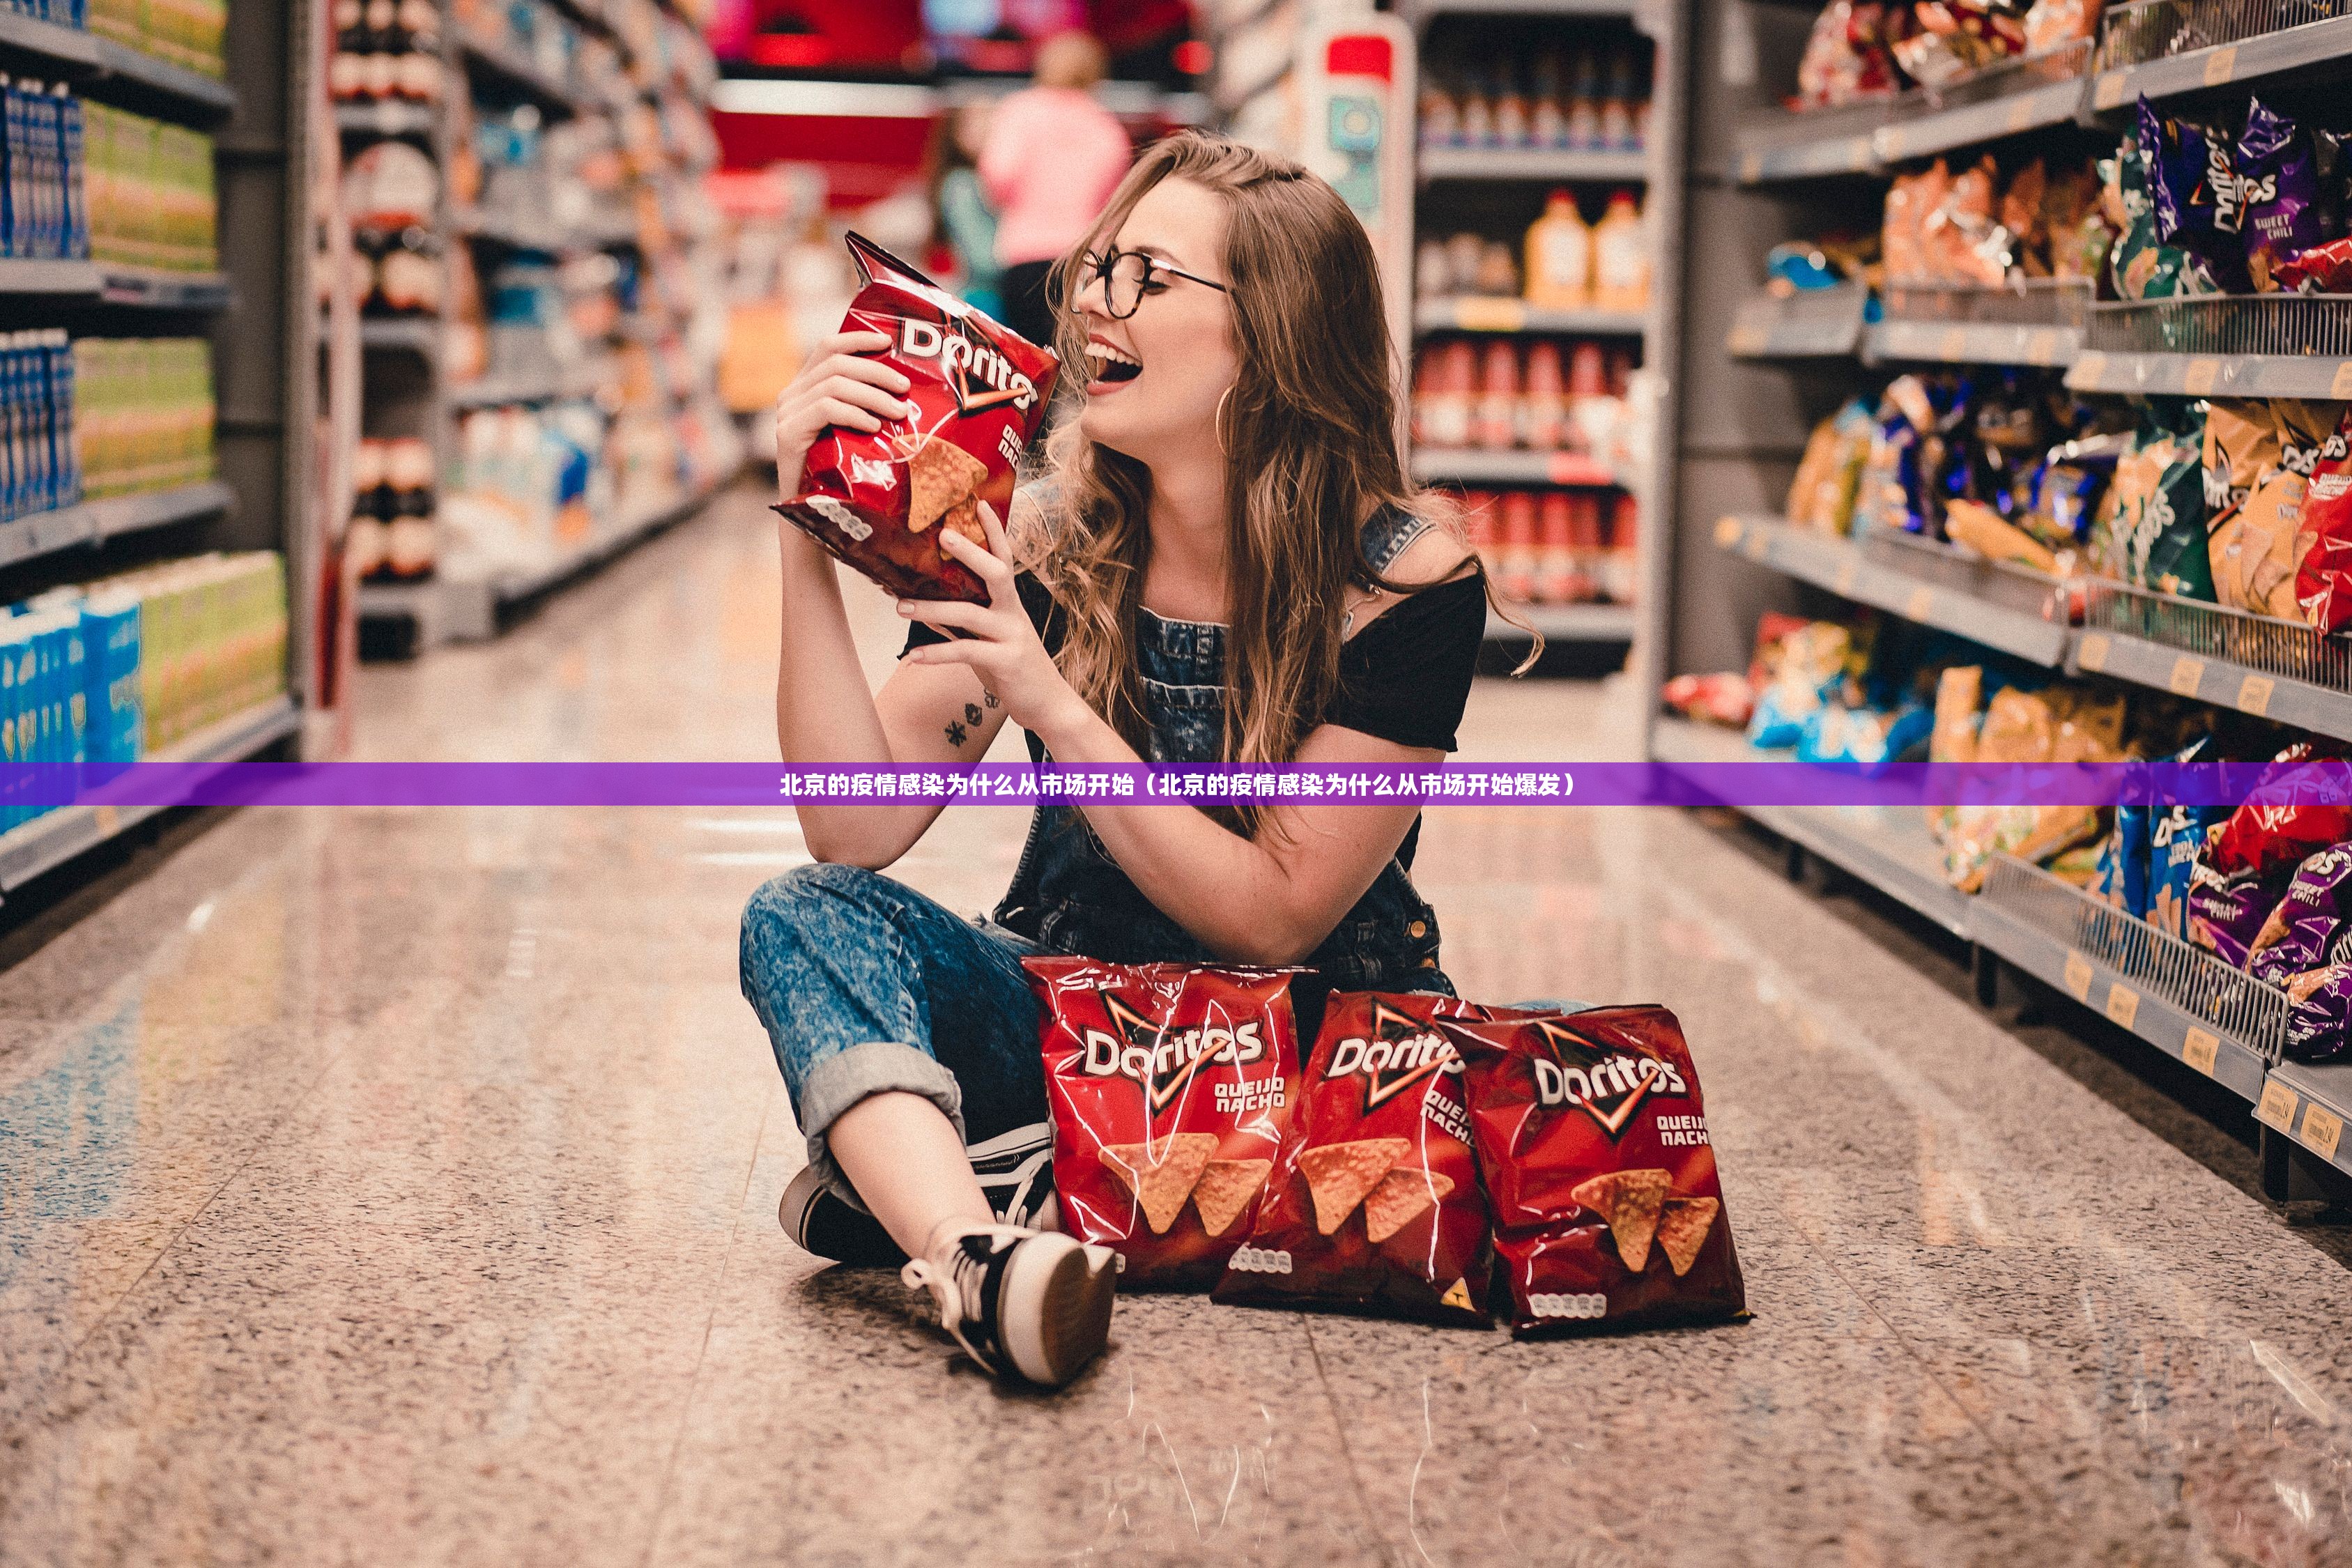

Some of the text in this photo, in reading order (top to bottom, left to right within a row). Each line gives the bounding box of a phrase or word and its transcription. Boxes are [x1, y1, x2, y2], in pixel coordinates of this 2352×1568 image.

[998, 438, 1019, 469] NAC
[1002, 424, 1023, 454] QUE
[1085, 1022, 1263, 1079] Doritos
[1328, 1033, 1466, 1077] Dorito
[1215, 1077, 1284, 1098] QUEIJO
[1534, 1055, 1686, 1105] Doritos
[1216, 1092, 1285, 1113] NACHO
[1424, 1089, 1470, 1125] QUEI
[1661, 1131, 1709, 1146] NACH
